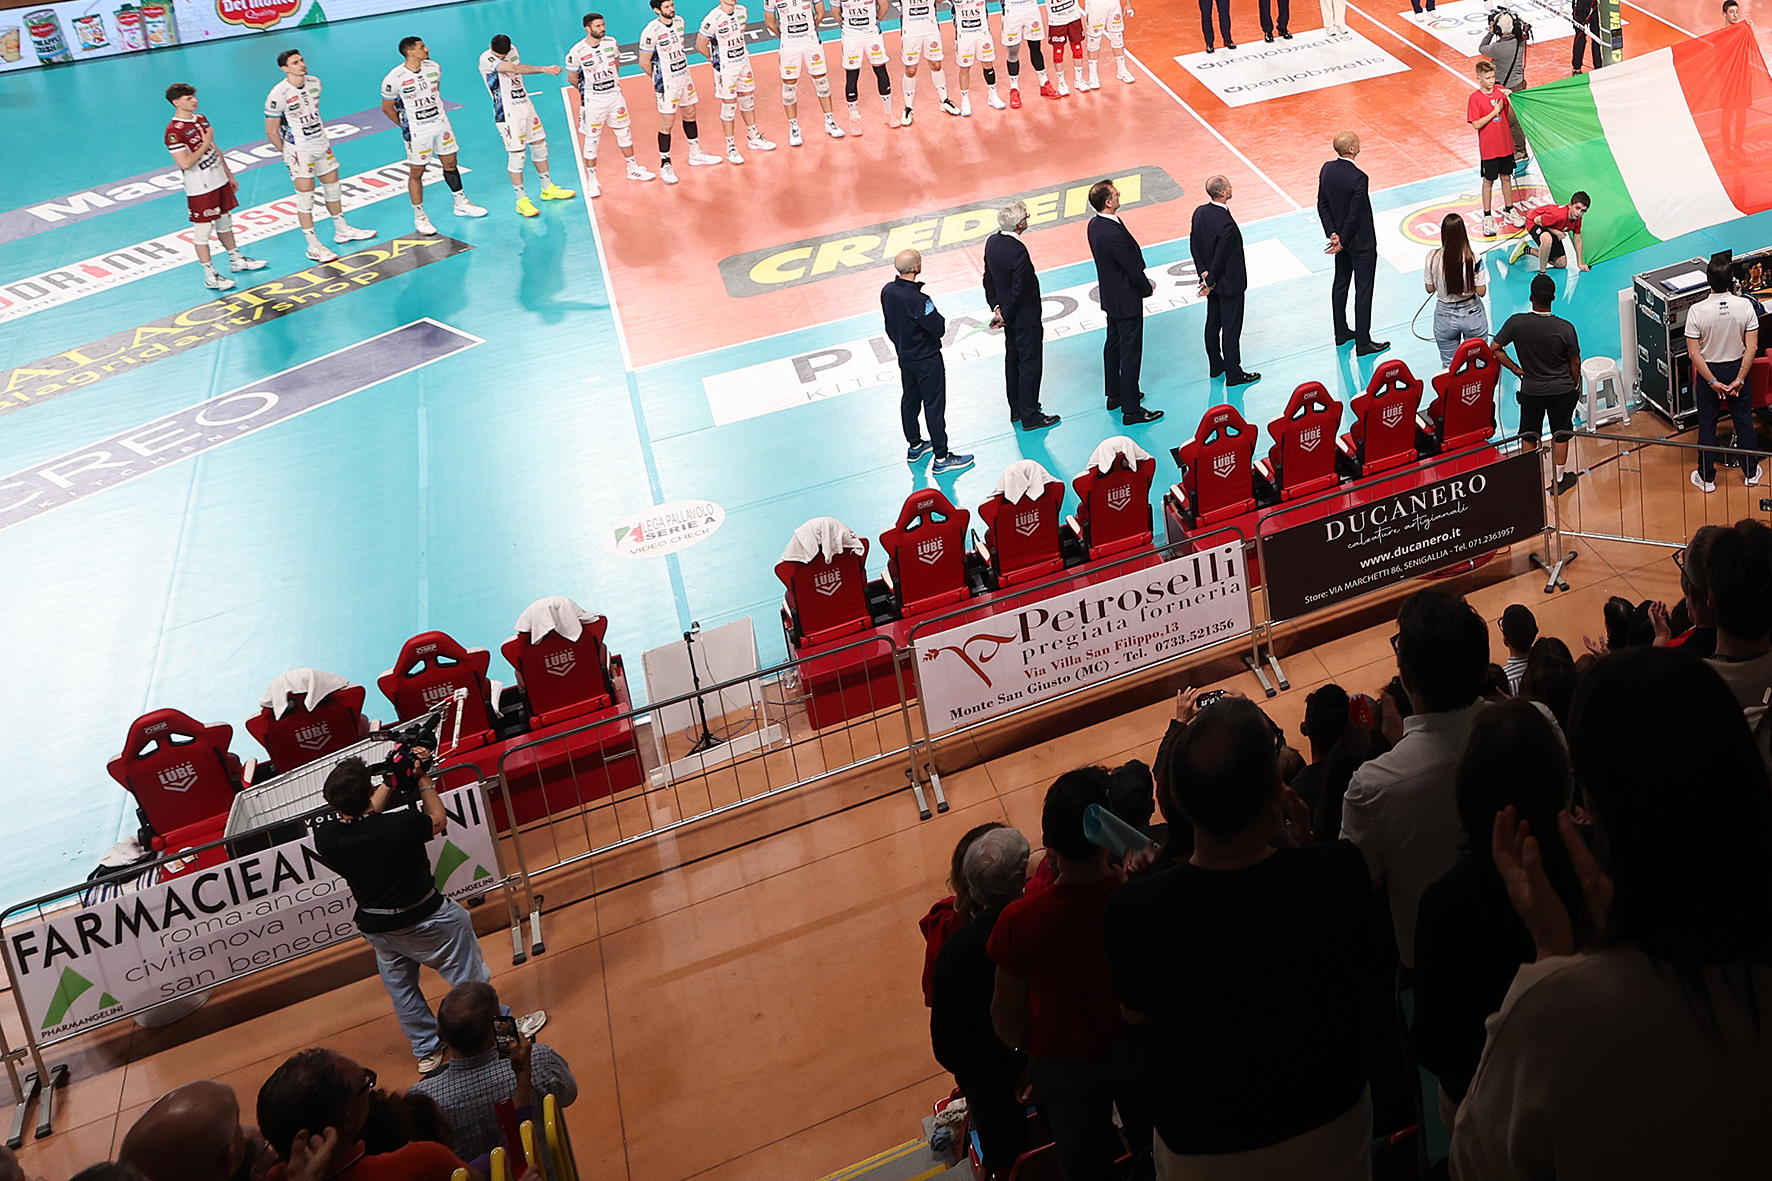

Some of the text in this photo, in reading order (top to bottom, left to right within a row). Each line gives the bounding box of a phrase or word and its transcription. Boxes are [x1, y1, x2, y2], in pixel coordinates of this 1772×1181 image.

[415, 95, 436, 108] ITAS
[750, 174, 1142, 285] CREDEM
[918, 539, 943, 556] LUBE
[1304, 526, 1515, 604] Store: MARCHETTI SENIGALLIA 071.2363957
[1360, 527, 1462, 569] www.ducanero.it
[1013, 547, 1238, 646] Petroselli
[1021, 581, 1241, 665] pregiata forneria
[950, 618, 1235, 721] Monte San Giusto (MC) Tel. 0733.521356
[1023, 621, 1180, 681] Via Villa San Filippo,13
[159, 763, 197, 787] LUBE
[126, 918, 284, 983] civitanova
[160, 968, 214, 998] san
[41, 1005, 124, 1039] PHARMANGELINI
